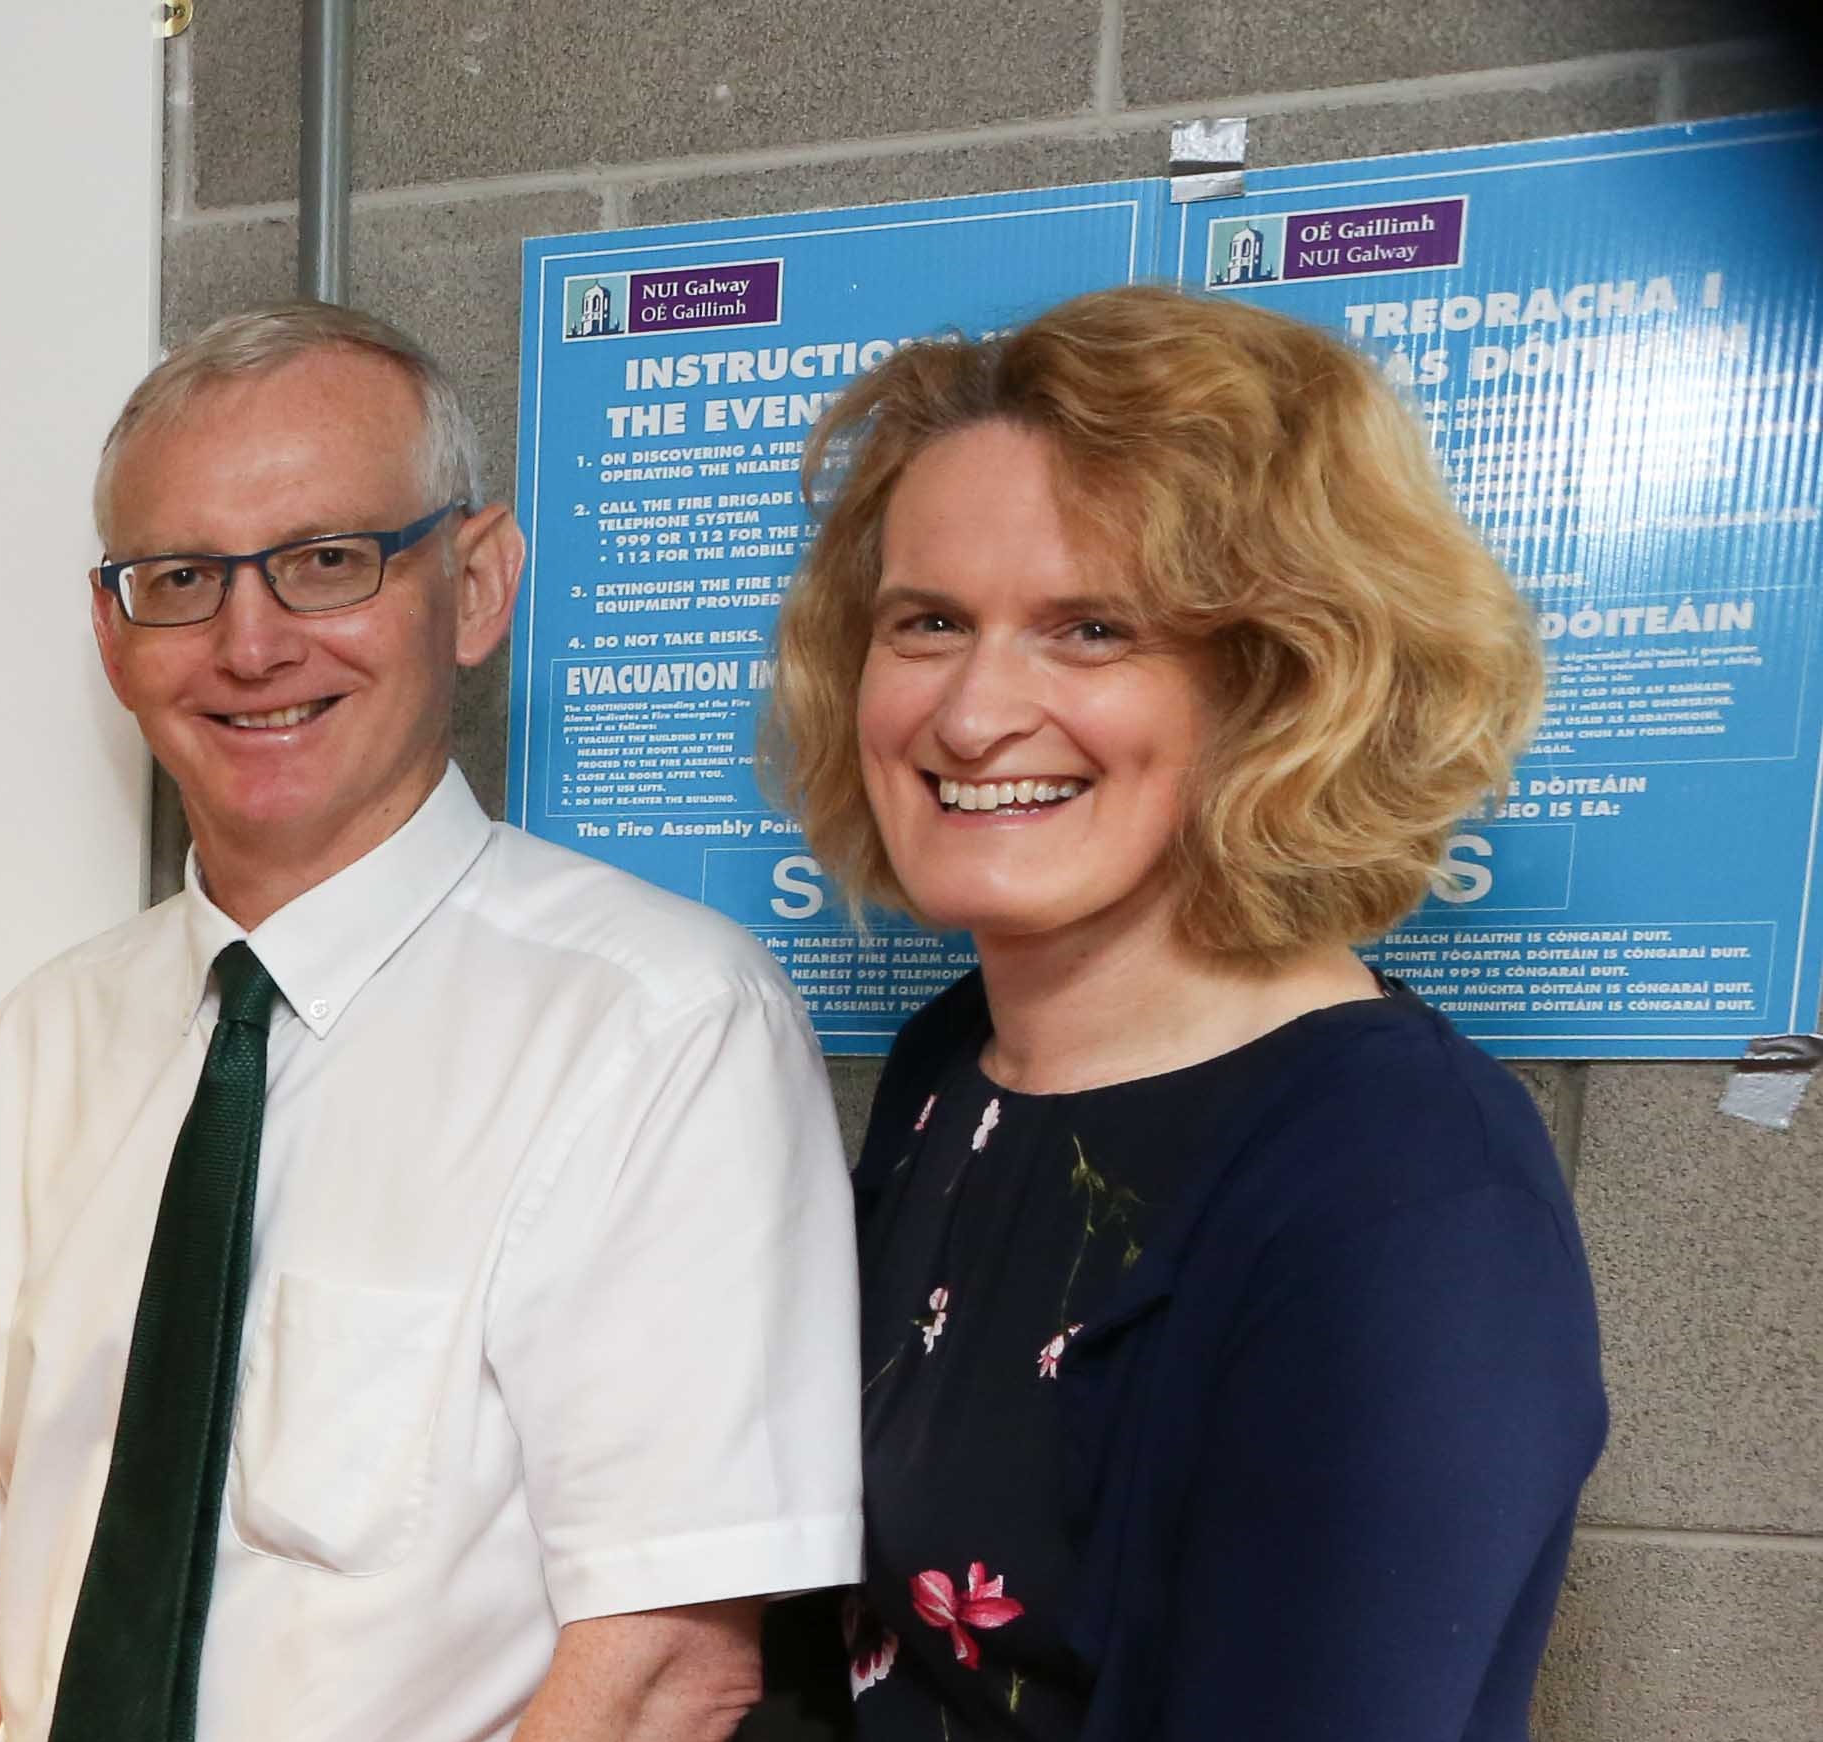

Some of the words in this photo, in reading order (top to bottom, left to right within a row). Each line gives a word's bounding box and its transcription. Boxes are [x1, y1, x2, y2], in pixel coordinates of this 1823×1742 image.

[1301, 217, 1333, 243] OÉ
[1338, 213, 1434, 240] Gaillimh
[1299, 247, 1340, 268] NUI
[1347, 242, 1417, 265] Galway
[642, 282, 678, 299] NUI
[684, 277, 751, 297] Galway
[641, 303, 667, 323] OÉ
[673, 299, 746, 320] Gaillimh
[1345, 278, 1676, 338] TREORACHA
[1704, 272, 1723, 309] I
[1366, 343, 1448, 385] ÁS
[606, 402, 686, 438] THE
[577, 455, 593, 468] 1.
[601, 453, 626, 466] ON
[632, 443, 745, 464] DISCOVERING
[751, 443, 763, 456] A
[770, 440, 805, 455] FIRE
[600, 464, 693, 483] OPERATING
[700, 461, 729, 476] THE
[736, 458, 802, 475] NEARES
[574, 504, 590, 517] 2.
[600, 501, 636, 515] CALL
[643, 499, 671, 513] THE
[678, 497, 712, 510] FIRE
[718, 492, 793, 508] BRIGADE
[598, 515, 690, 532] TELEPHONE
[695, 511, 759, 526] SYSTEM
[615, 534, 650, 547] 999
[657, 532, 681, 545] OR
[689, 530, 723, 543] 112
[729, 528, 762, 541] FOR
[768, 525, 798, 539] THE
[617, 551, 650, 564] 112
[656, 549, 689, 562] FOR
[695, 546, 724, 560] THE
[730, 543, 794, 558] MOBILE
[570, 586, 587, 598] 3.
[596, 581, 695, 597] EXTINGUISH
[700, 578, 730, 591] THE
[736, 576, 771, 590] FIRE
[595, 597, 691, 614] EQUIPMENT
[1536, 598, 1754, 641] DÓITEÁIN
[568, 637, 585, 649] 4.
[594, 635, 618, 648] DO
[625, 634, 659, 647] NOT
[664, 632, 704, 646] TAKE
[709, 630, 763, 644] RISKS.
[566, 661, 738, 696] EVACUATION
[584, 702, 647, 712] CONTINUOUS
[628, 734, 646, 743] THE
[700, 732, 713, 741] BY
[716, 732, 734, 740] THE
[577, 747, 619, 756] NEAREST
[622, 746, 644, 755] EXIT
[647, 745, 679, 755] ROUTE
[682, 745, 703, 754] AND
[706, 744, 733, 753] THEN
[577, 759, 620, 769] PROCEED
[623, 758, 636, 768] TO
[639, 758, 656, 767] THE
[660, 758, 681, 767] FIRE
[684, 757, 735, 766] ASSEMBLY
[576, 772, 605, 782] CLOSE
[608, 772, 625, 781] ALL
[628, 771, 663, 780] DOORS
[666, 770, 696, 779] AFTER
[1529, 774, 1648, 796] DÓITEÁIN
[576, 785, 591, 794] DO
[593, 785, 614, 794] NOT
[575, 798, 590, 806] DO
[593, 797, 614, 806] NOT
[665, 796, 683, 805] THE
[1549, 801, 1573, 817] IS
[1580, 800, 1621, 817] EA:
[577, 822, 610, 837] The
[617, 822, 654, 837] Fire
[661, 819, 753, 838] Assembly
[767, 938, 788, 948] the
[794, 937, 853, 948] NEAREST
[894, 937, 944, 948] ROUTE.
[1385, 933, 1449, 945] BEALACH
[1527, 932, 1541, 943] IS
[1633, 931, 1673, 942] DUIT.
[793, 953, 853, 964] NEAREST
[858, 953, 886, 964] FIRE
[892, 953, 942, 964] ALARM
[1385, 951, 1437, 962] POINTE
[1442, 947, 1521, 961] FÓGARTHA
[1527, 947, 1598, 960] DÓITEÁIN
[1603, 949, 1618, 959] IS
[1710, 946, 1751, 958] DUIT.
[792, 968, 852, 980] NEAREST
[857, 969, 886, 980] 999
[1449, 968, 1481, 978] 999
[1486, 967, 1500, 977] IS
[1590, 966, 1629, 977] DUIT.
[856, 985, 885, 995] FIRE
[1464, 982, 1524, 995] MÚCHTA
[1529, 982, 1601, 994] DÓITEÁIN
[1606, 983, 1621, 994] IS
[1713, 982, 1754, 993] DUIT.
[823, 1001, 896, 1012] ASSEMBLY
[1531, 998, 1603, 1011] DÓITEÁIN
[1608, 1000, 1623, 1011] IS
[1715, 1000, 1755, 1011] DUIT.
